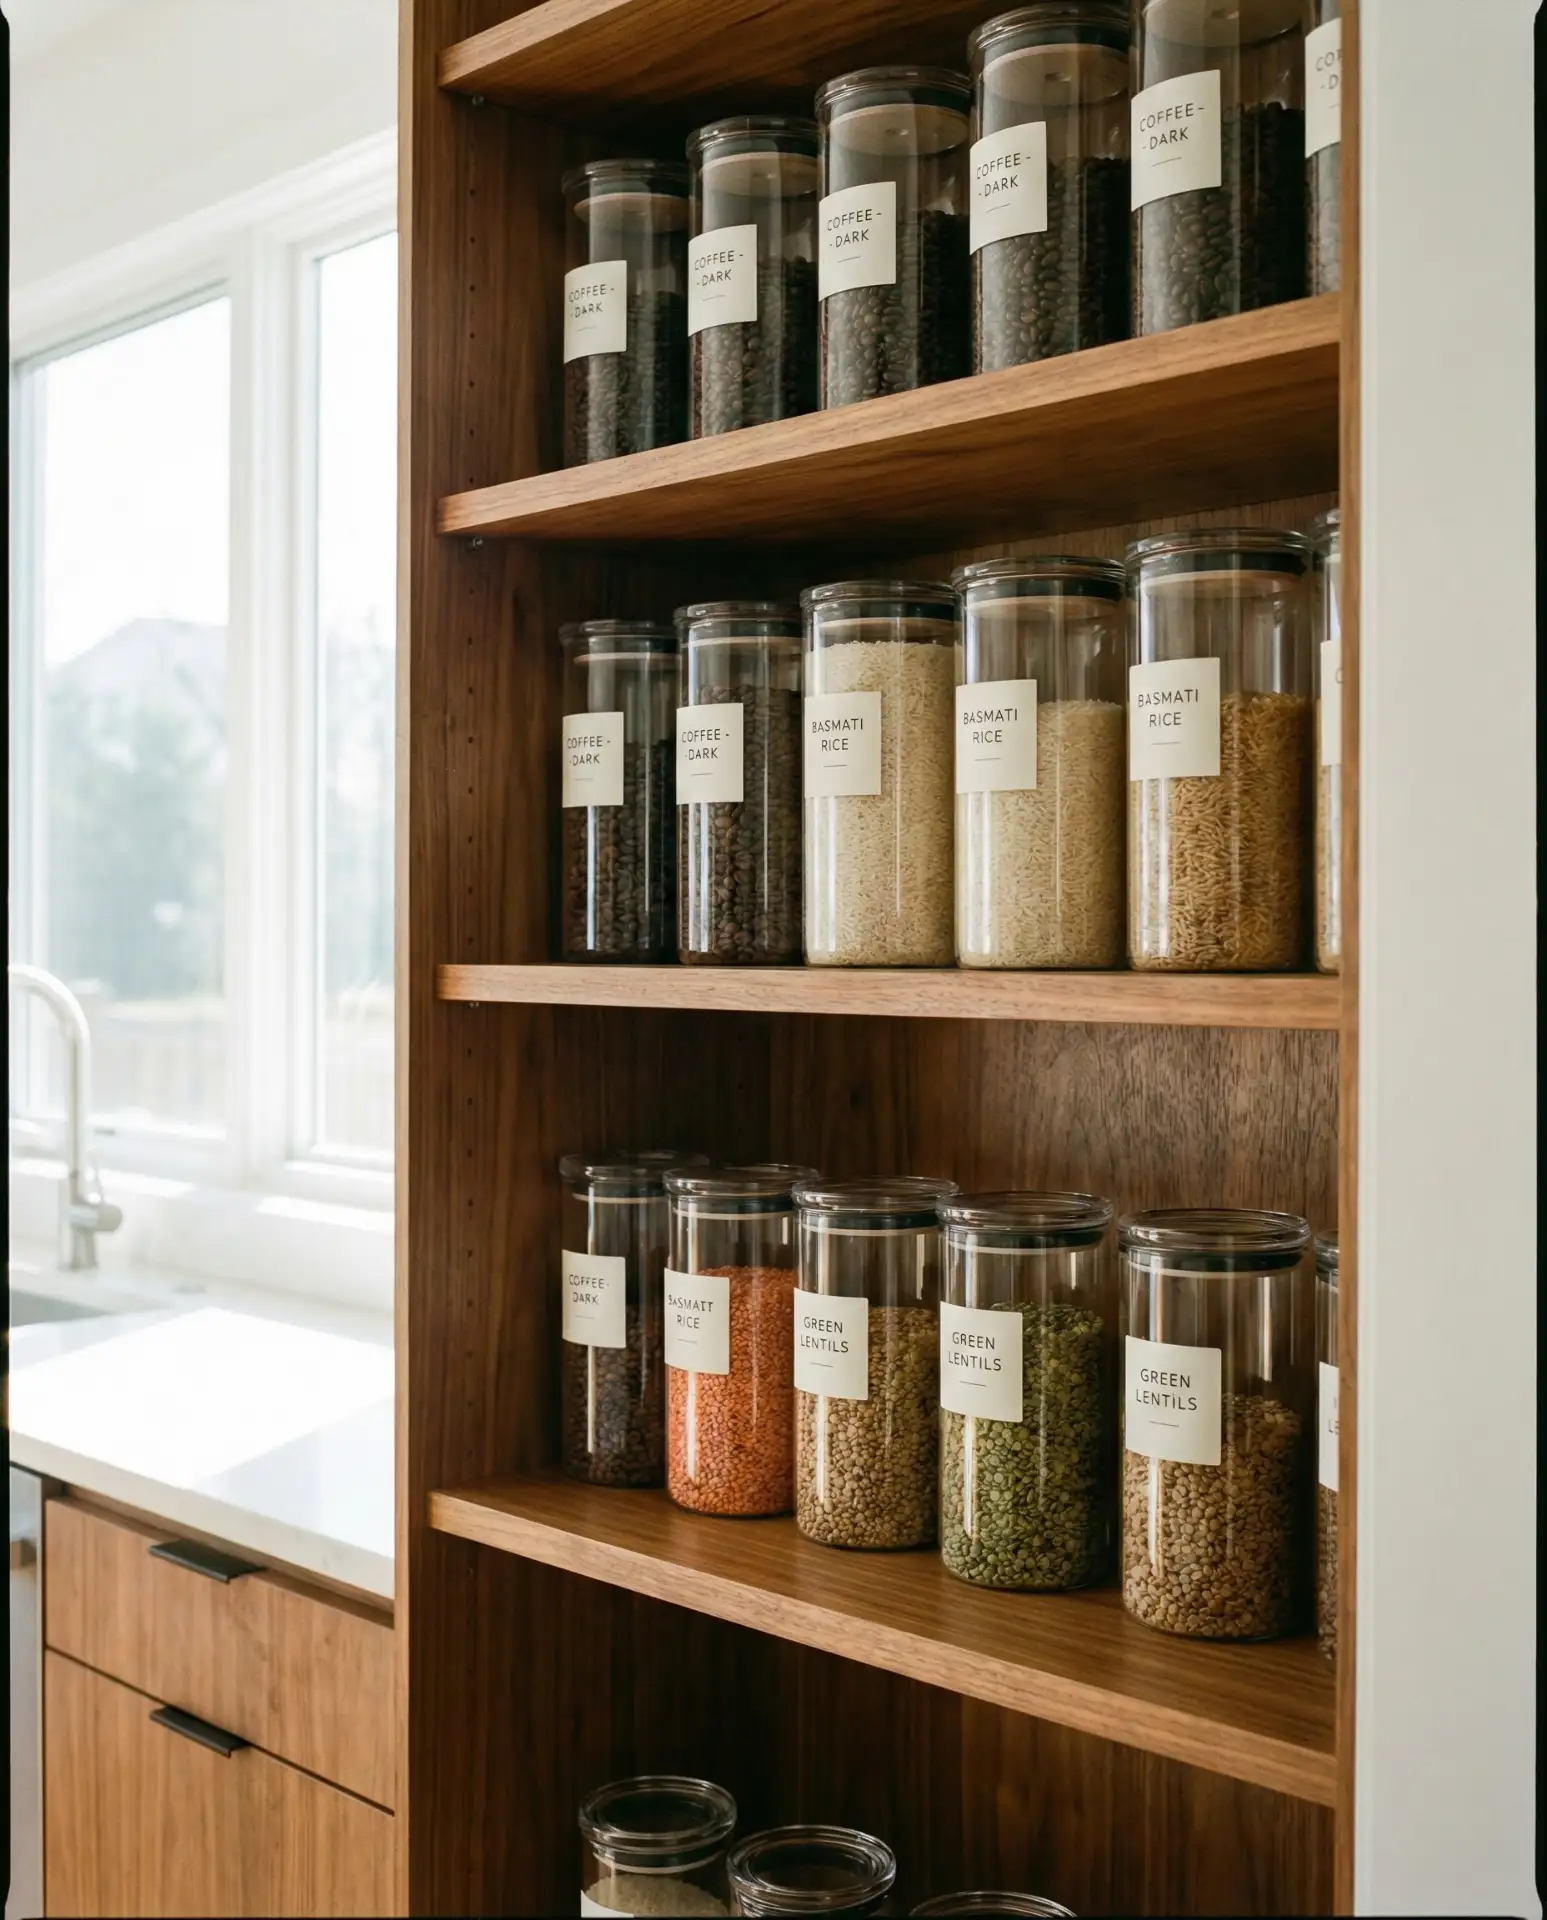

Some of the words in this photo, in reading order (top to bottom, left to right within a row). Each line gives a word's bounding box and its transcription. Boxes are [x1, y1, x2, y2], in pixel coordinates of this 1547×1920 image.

[1137, 689, 1199, 708] BASMATI
[812, 718, 864, 733] BASMATI
[963, 708, 1018, 725] BASMATI
[1148, 712, 1182, 728] RICE
[821, 738, 849, 752] RICE
[972, 730, 1003, 744] RICE
[676, 1314, 700, 1329] RICE
[803, 1316, 843, 1334] GREEN
[800, 1335, 849, 1353] LENTILS
[952, 1331, 996, 1350] GREEN
[948, 1350, 1002, 1372] LENTILS
[1140, 1368, 1191, 1389] GREEN
[1135, 1389, 1198, 1412] LENTILS
